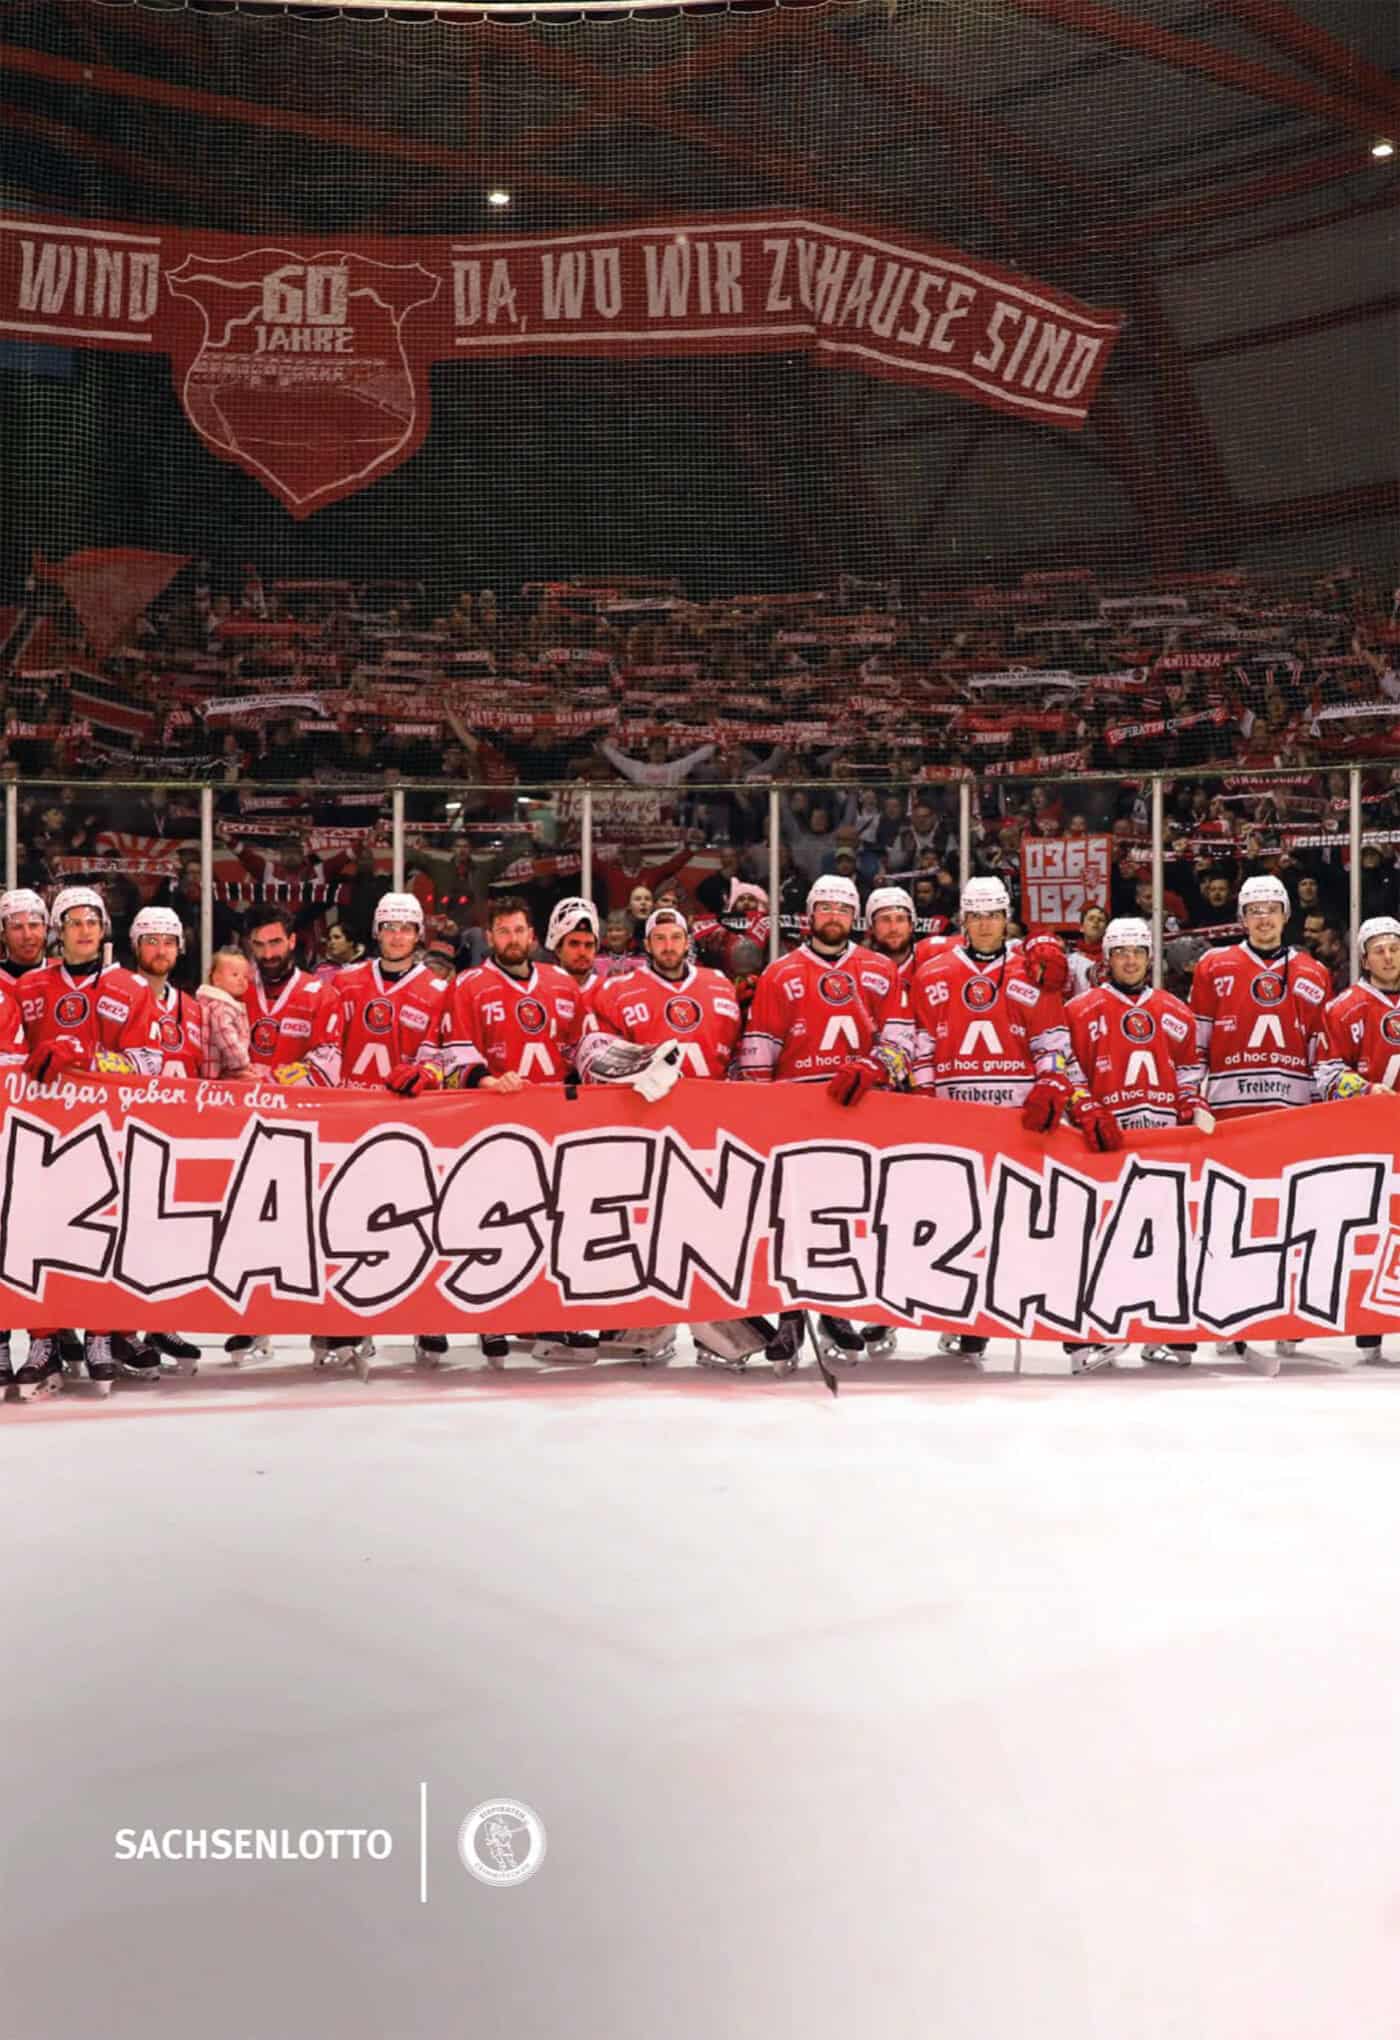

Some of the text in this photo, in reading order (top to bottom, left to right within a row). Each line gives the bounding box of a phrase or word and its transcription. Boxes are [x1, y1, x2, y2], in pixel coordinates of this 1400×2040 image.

[20, 240, 161, 322] WIND
[262, 264, 349, 325] 60
[453, 258, 526, 334] DA,
[540, 247, 622, 321] WO
[642, 240, 744, 318] WIR
[972, 301, 1105, 400] SIND
[253, 325, 354, 353] JAHRE
[782, 976, 806, 1001] 15
[925, 981, 950, 1007] 26
[1213, 975, 1235, 998] 27
[21, 998, 45, 1022] 22
[481, 1000, 506, 1025] 75
[622, 1002, 651, 1028] 20
[795, 1055, 812, 1069] ad
[815, 1054, 841, 1066] hoc
[953, 1058, 979, 1070] hoc
[1224, 1053, 1242, 1066] ad
[1243, 1051, 1268, 1064] hoc
[118, 1078, 187, 1112] geben
[195, 1080, 235, 1112] für
[243, 1082, 288, 1110] den
[947, 1086, 1015, 1106] Freiberger
[1121, 1088, 1145, 1101] hoc
[1, 1113, 1386, 1336] KLASSENERHALT
